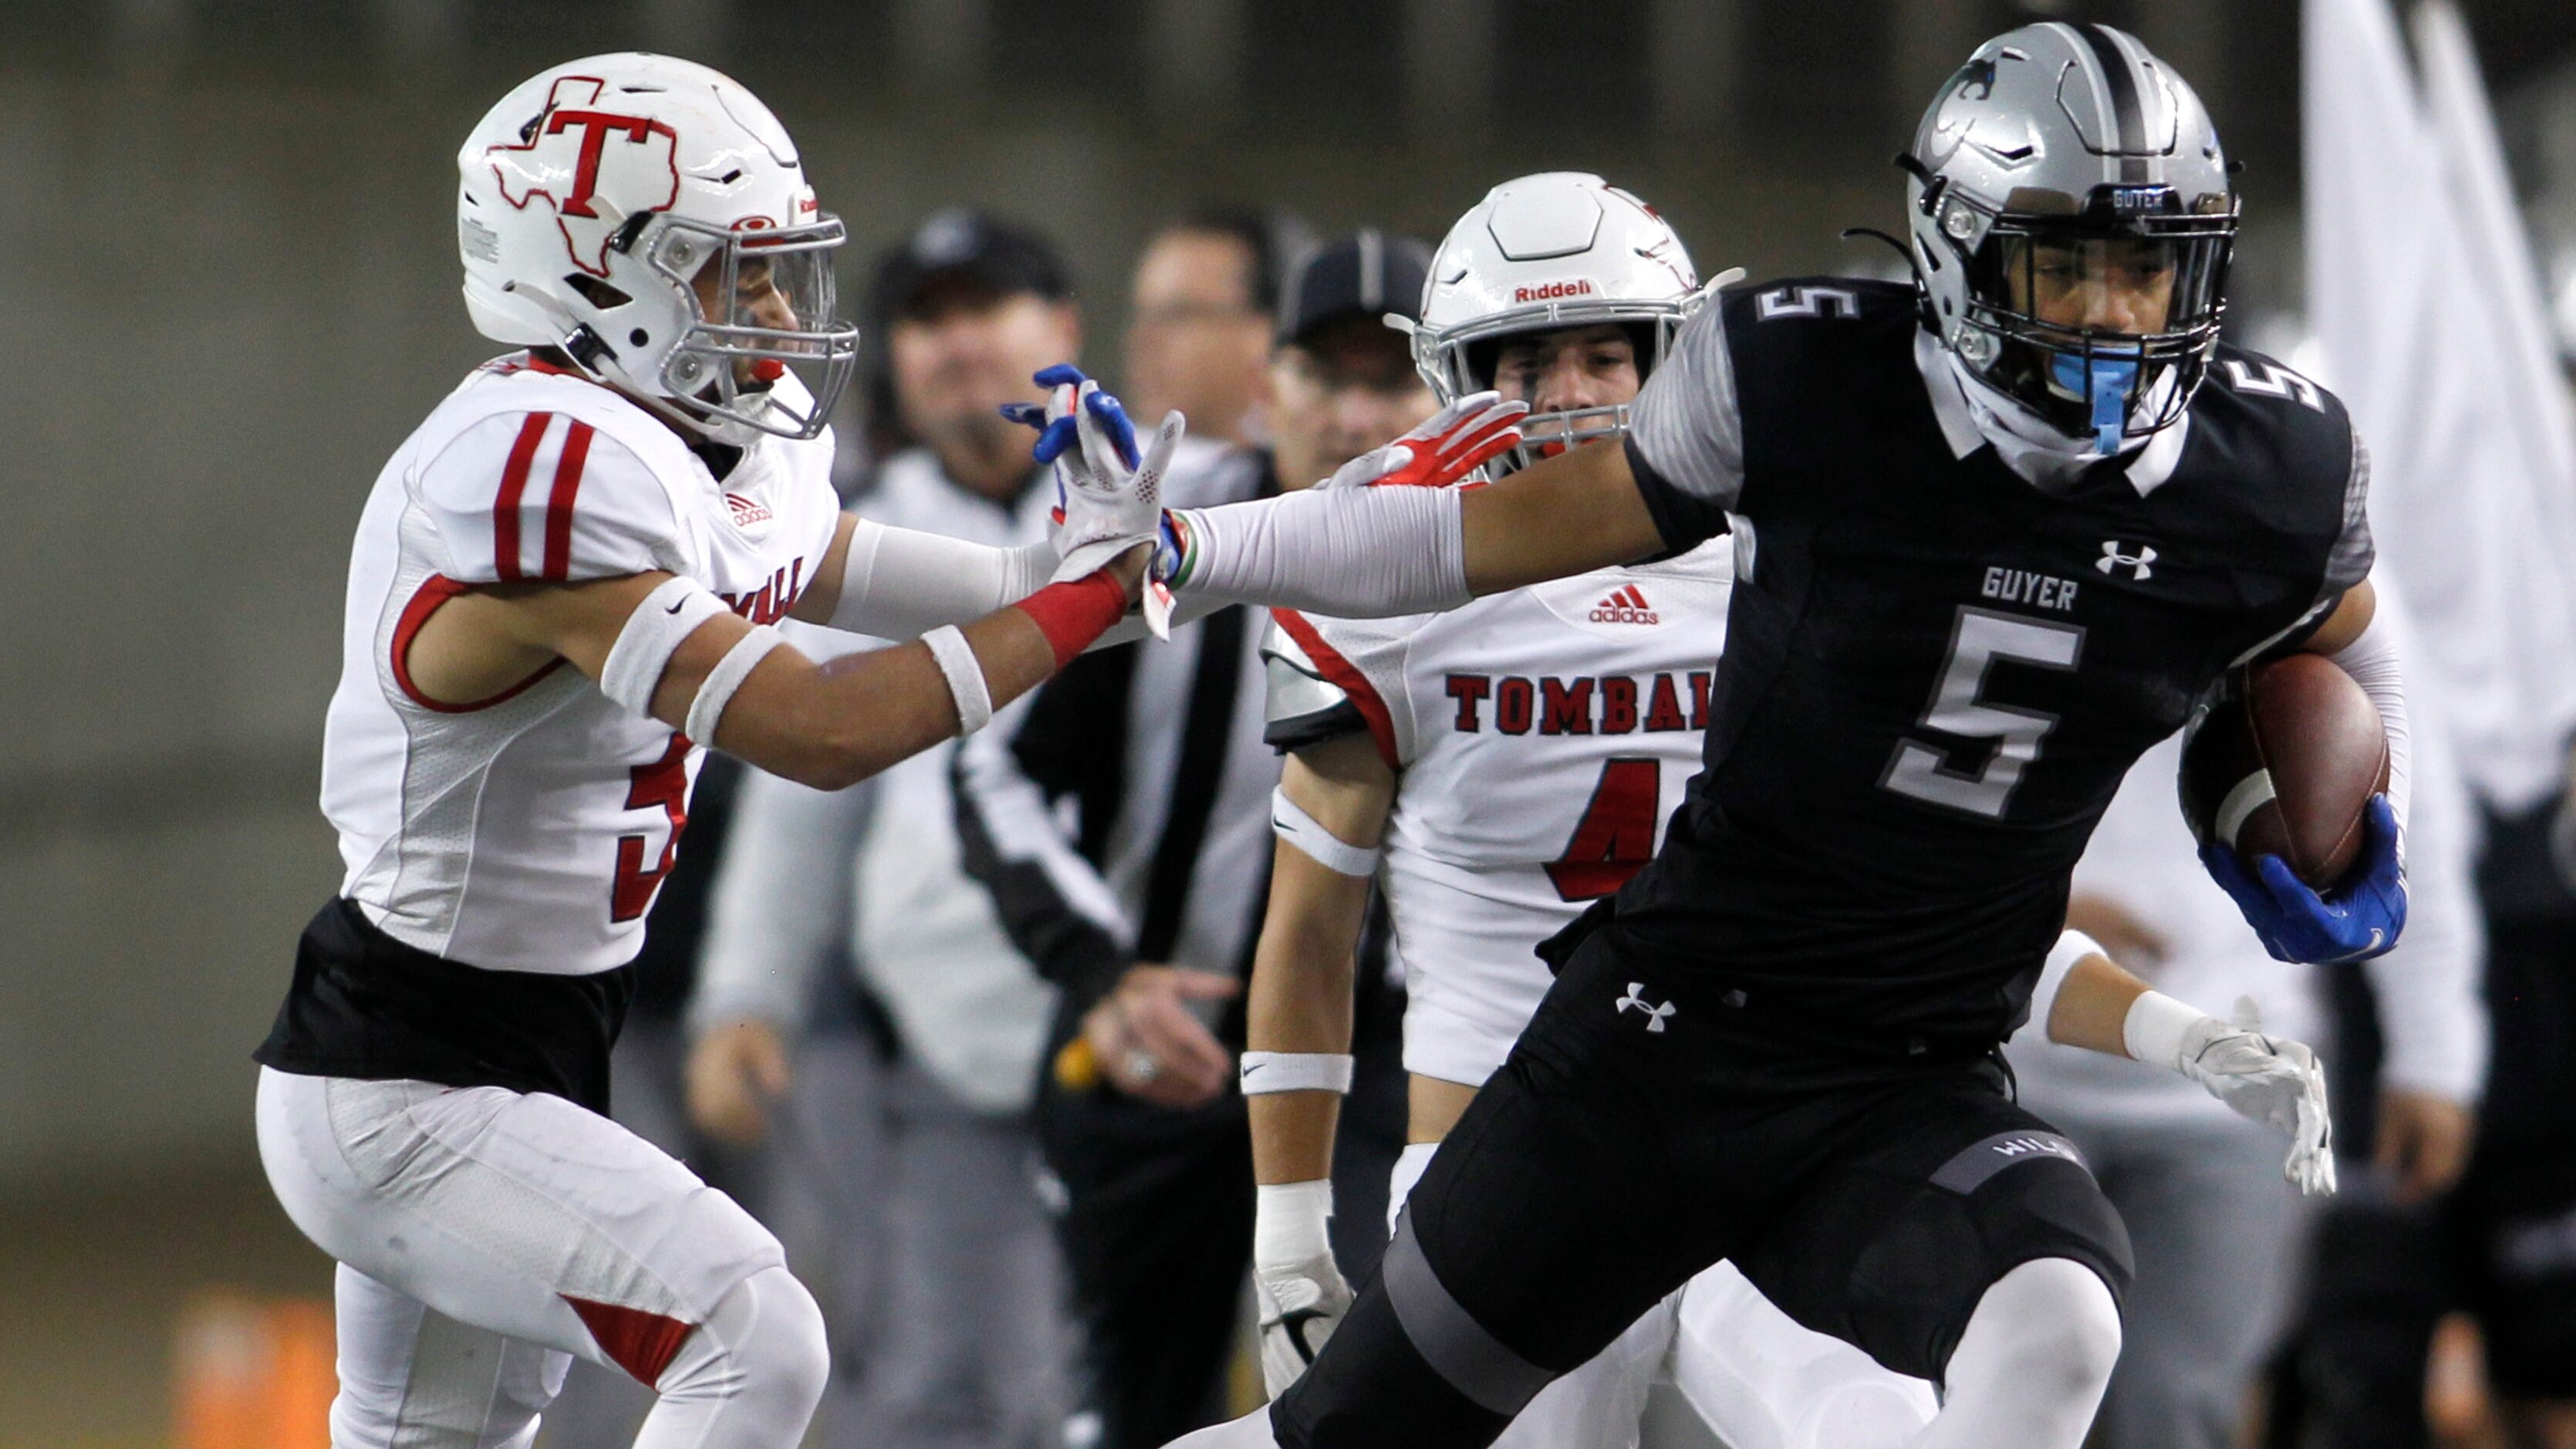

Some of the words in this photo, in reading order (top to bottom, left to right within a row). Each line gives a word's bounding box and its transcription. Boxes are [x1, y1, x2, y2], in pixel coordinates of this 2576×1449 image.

[543, 110, 653, 219] T
[1514, 279, 1592, 303] Riddell
[1754, 285, 1861, 323] 5
[2221, 360, 2326, 414] 5
[1982, 566, 2078, 610] GUYER
[1589, 606, 1659, 625] adidas
[1875, 604, 2087, 821] 5
[1544, 757, 1660, 902] 4
